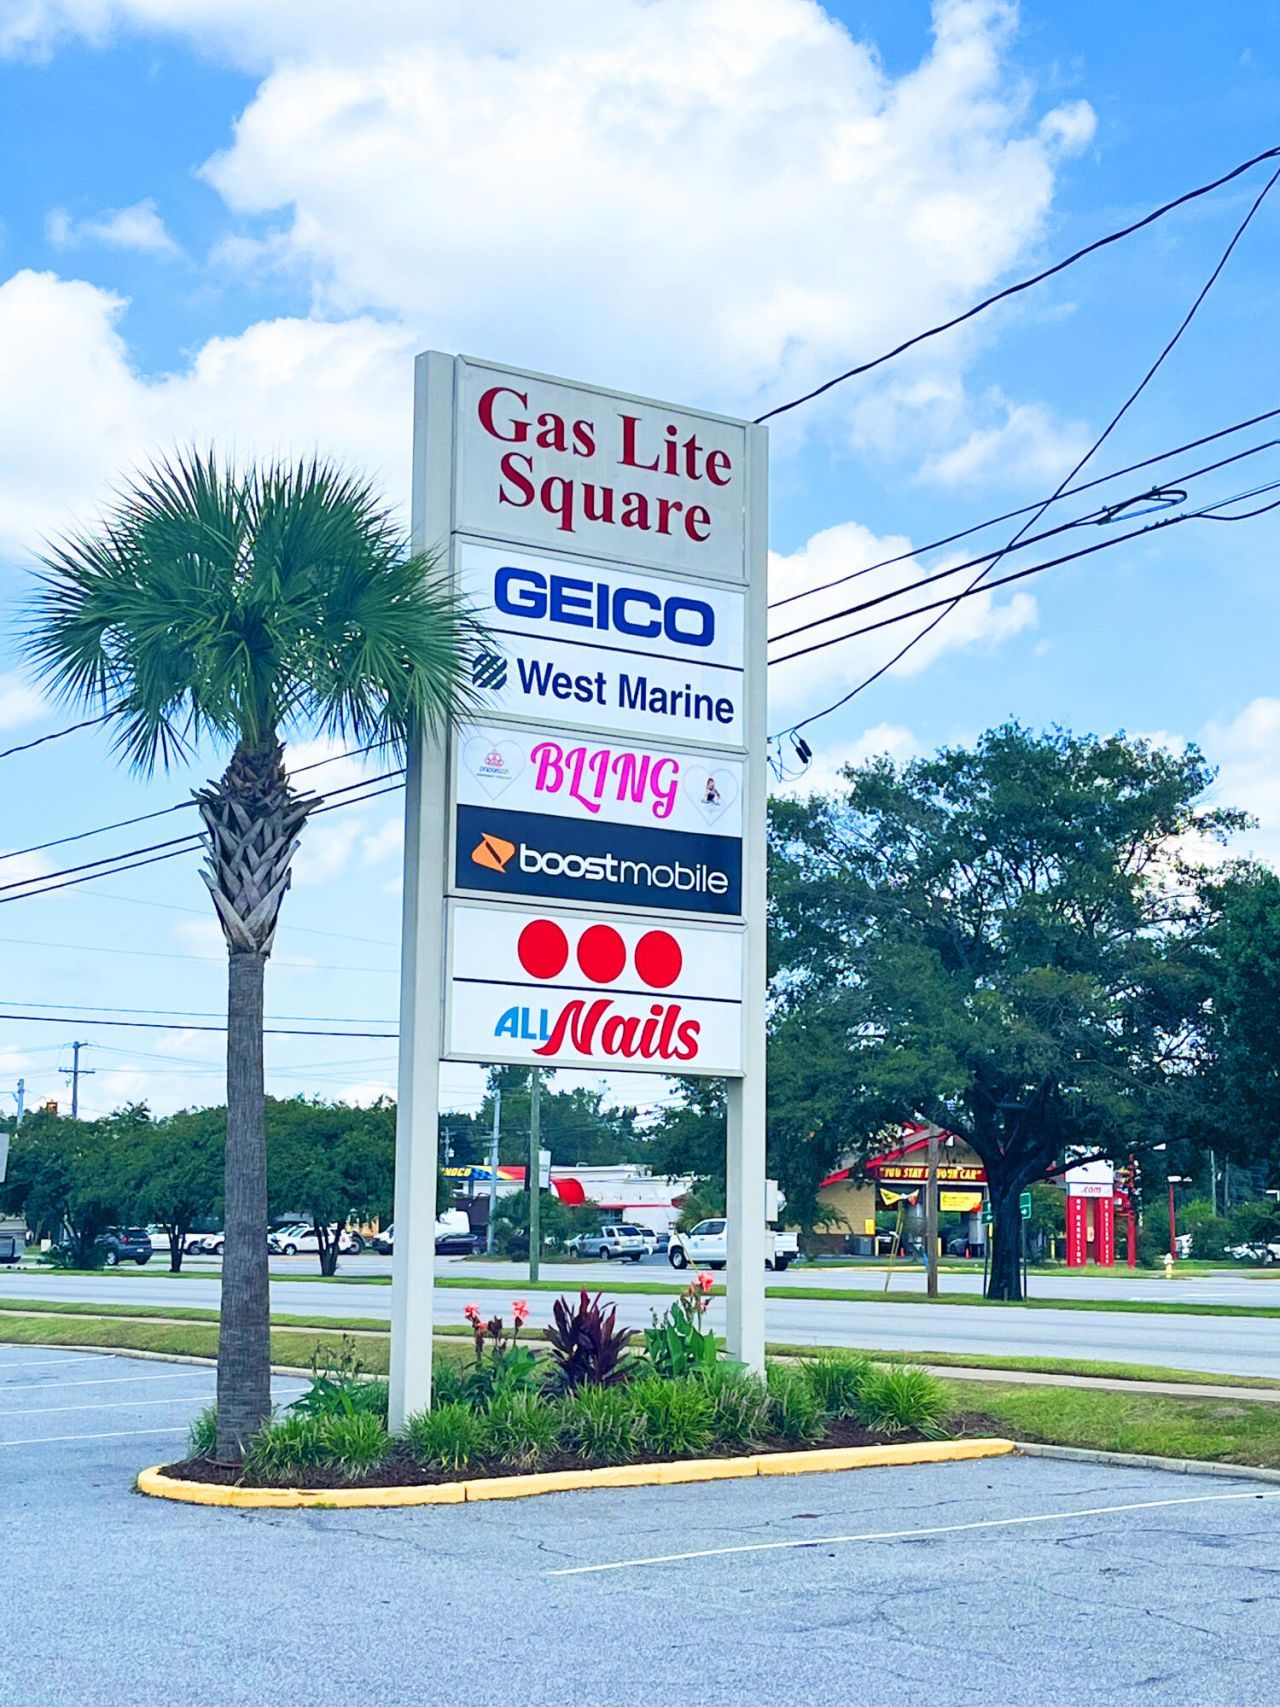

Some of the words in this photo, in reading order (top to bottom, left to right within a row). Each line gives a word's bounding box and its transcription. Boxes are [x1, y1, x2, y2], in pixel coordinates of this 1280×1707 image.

[477, 386, 596, 458] Gas
[616, 413, 732, 486] Lite
[498, 451, 711, 542] Square
[494, 566, 715, 647] GEICO
[516, 658, 607, 705] West
[618, 673, 734, 724] Marine
[530, 741, 680, 819] BLING
[494, 1006, 551, 1041] ALL
[532, 998, 701, 1061] Nails
[903, 1168, 923, 1178] STAY
